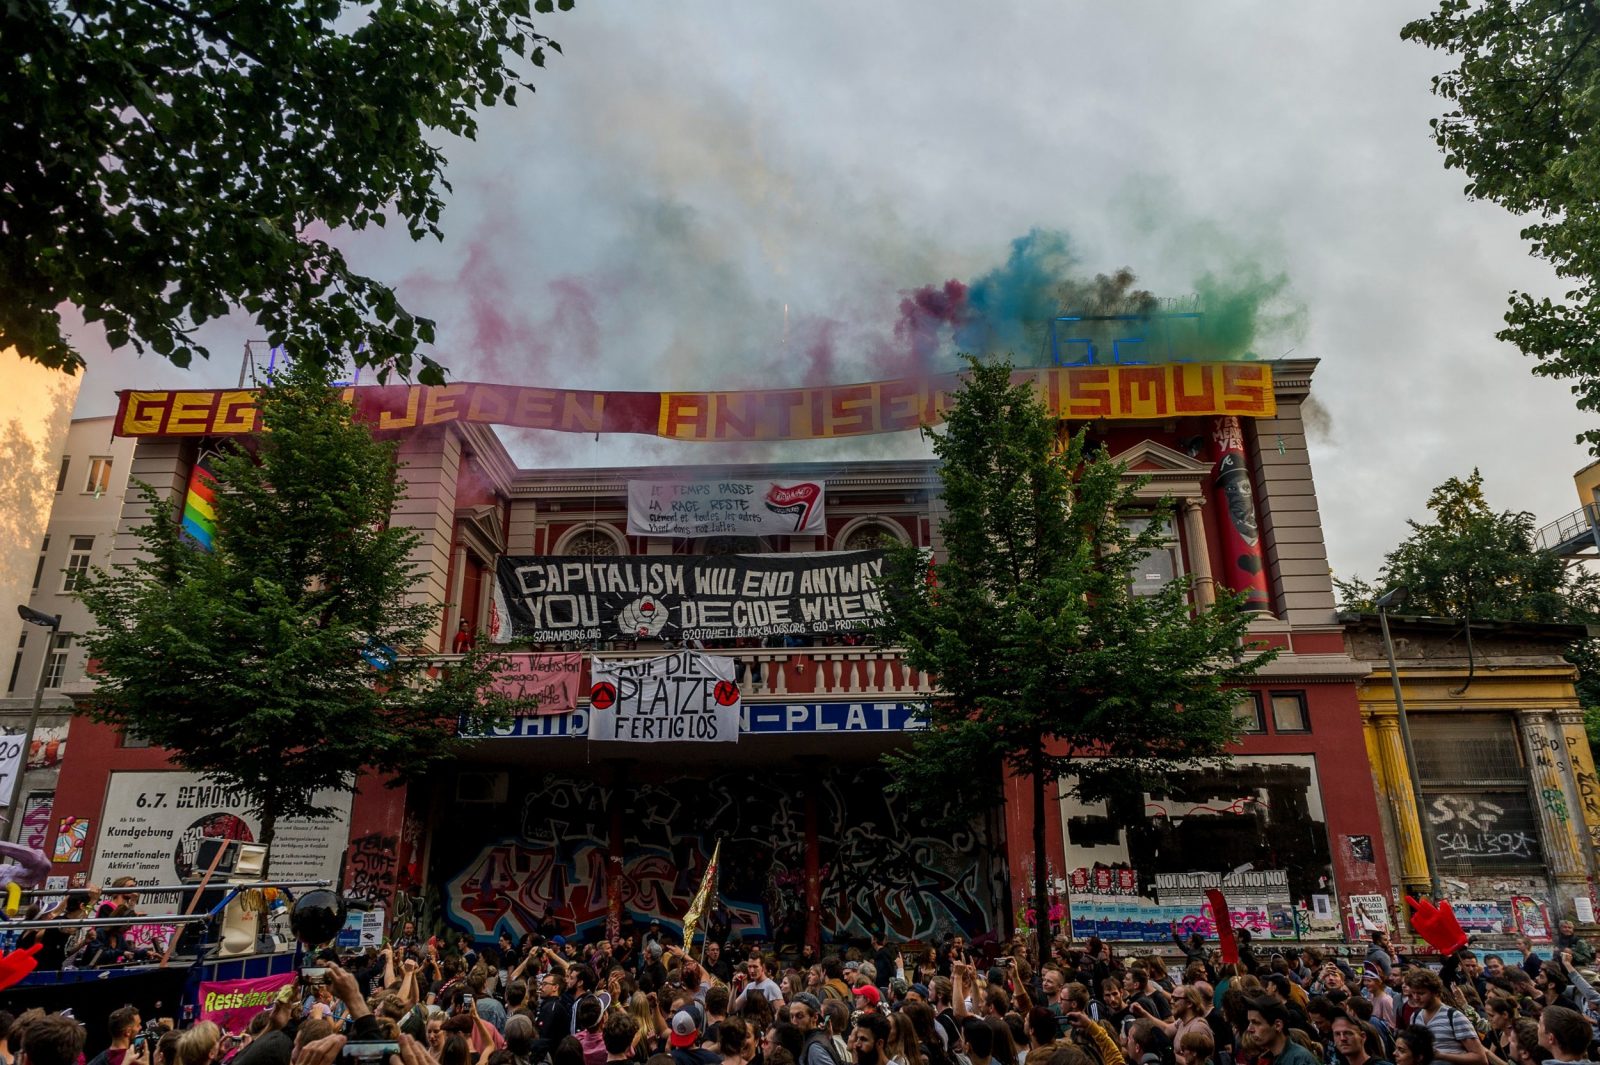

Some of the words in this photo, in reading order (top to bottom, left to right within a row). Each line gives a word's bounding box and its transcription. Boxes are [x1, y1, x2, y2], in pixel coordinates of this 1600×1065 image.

[122, 388, 355, 434] GEG
[379, 385, 604, 431] JEDEN
[1218, 438, 1243, 452] YES
[673, 484, 710, 495] TEMPS
[719, 484, 754, 495] PASSE
[649, 501, 661, 512] LA
[672, 500, 699, 512] RAGE
[711, 499, 749, 511] RESTE
[515, 562, 685, 594] CAPITALISM
[694, 567, 737, 596] WILL
[741, 569, 794, 597] END
[799, 558, 883, 594] ANYWAY
[525, 594, 600, 628] YOU
[681, 599, 792, 628] DECIDE
[619, 662, 655, 677] AUF
[666, 653, 701, 676] DIE
[616, 675, 717, 716] PLÄTZE
[136, 793, 168, 808] 6.7.
[107, 826, 174, 839] Kundgebung
[182, 826, 204, 843] G20
[101, 849, 171, 860] internationalen
[1157, 875, 1178, 889] NO!
[1201, 873, 1221, 887] NO!
[1244, 872, 1265, 887] NO!
[1266, 871, 1287, 886] NO!
[142, 892, 179, 905] ZITRONEN
